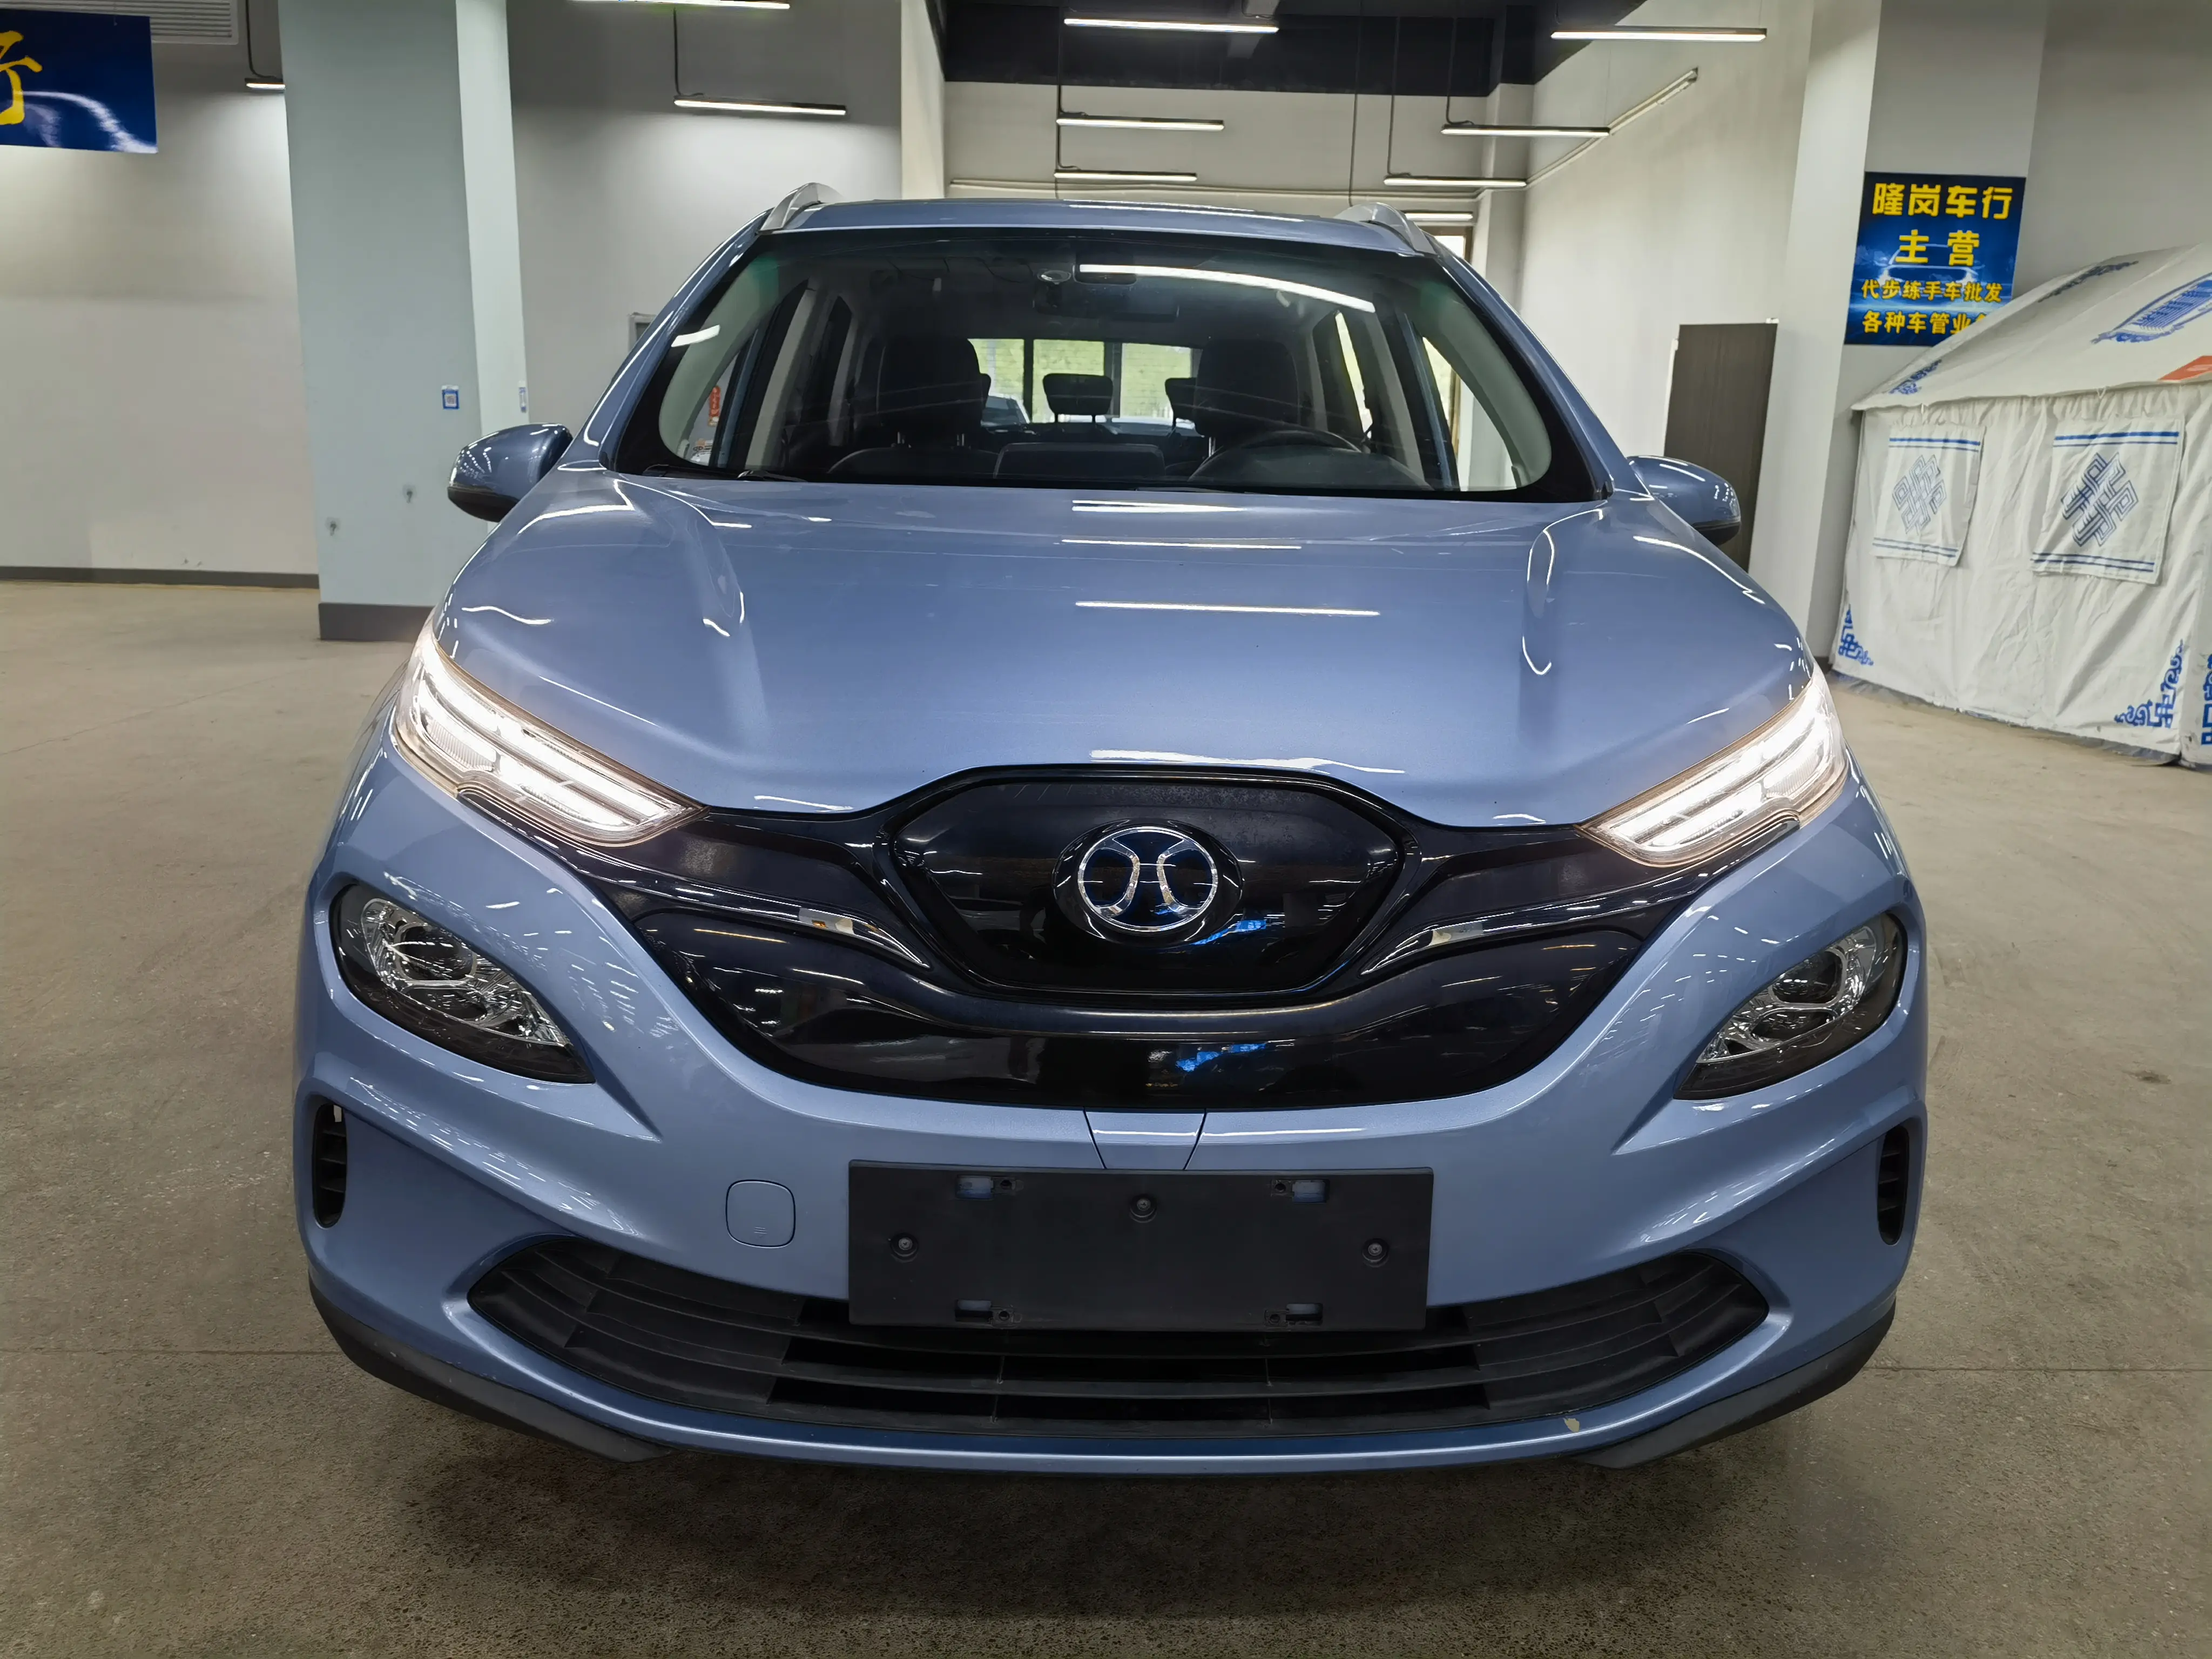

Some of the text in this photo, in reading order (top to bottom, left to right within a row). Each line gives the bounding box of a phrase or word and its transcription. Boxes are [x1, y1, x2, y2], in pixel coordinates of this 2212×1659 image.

[1861, 279, 2002, 303] 代步练手车批发
